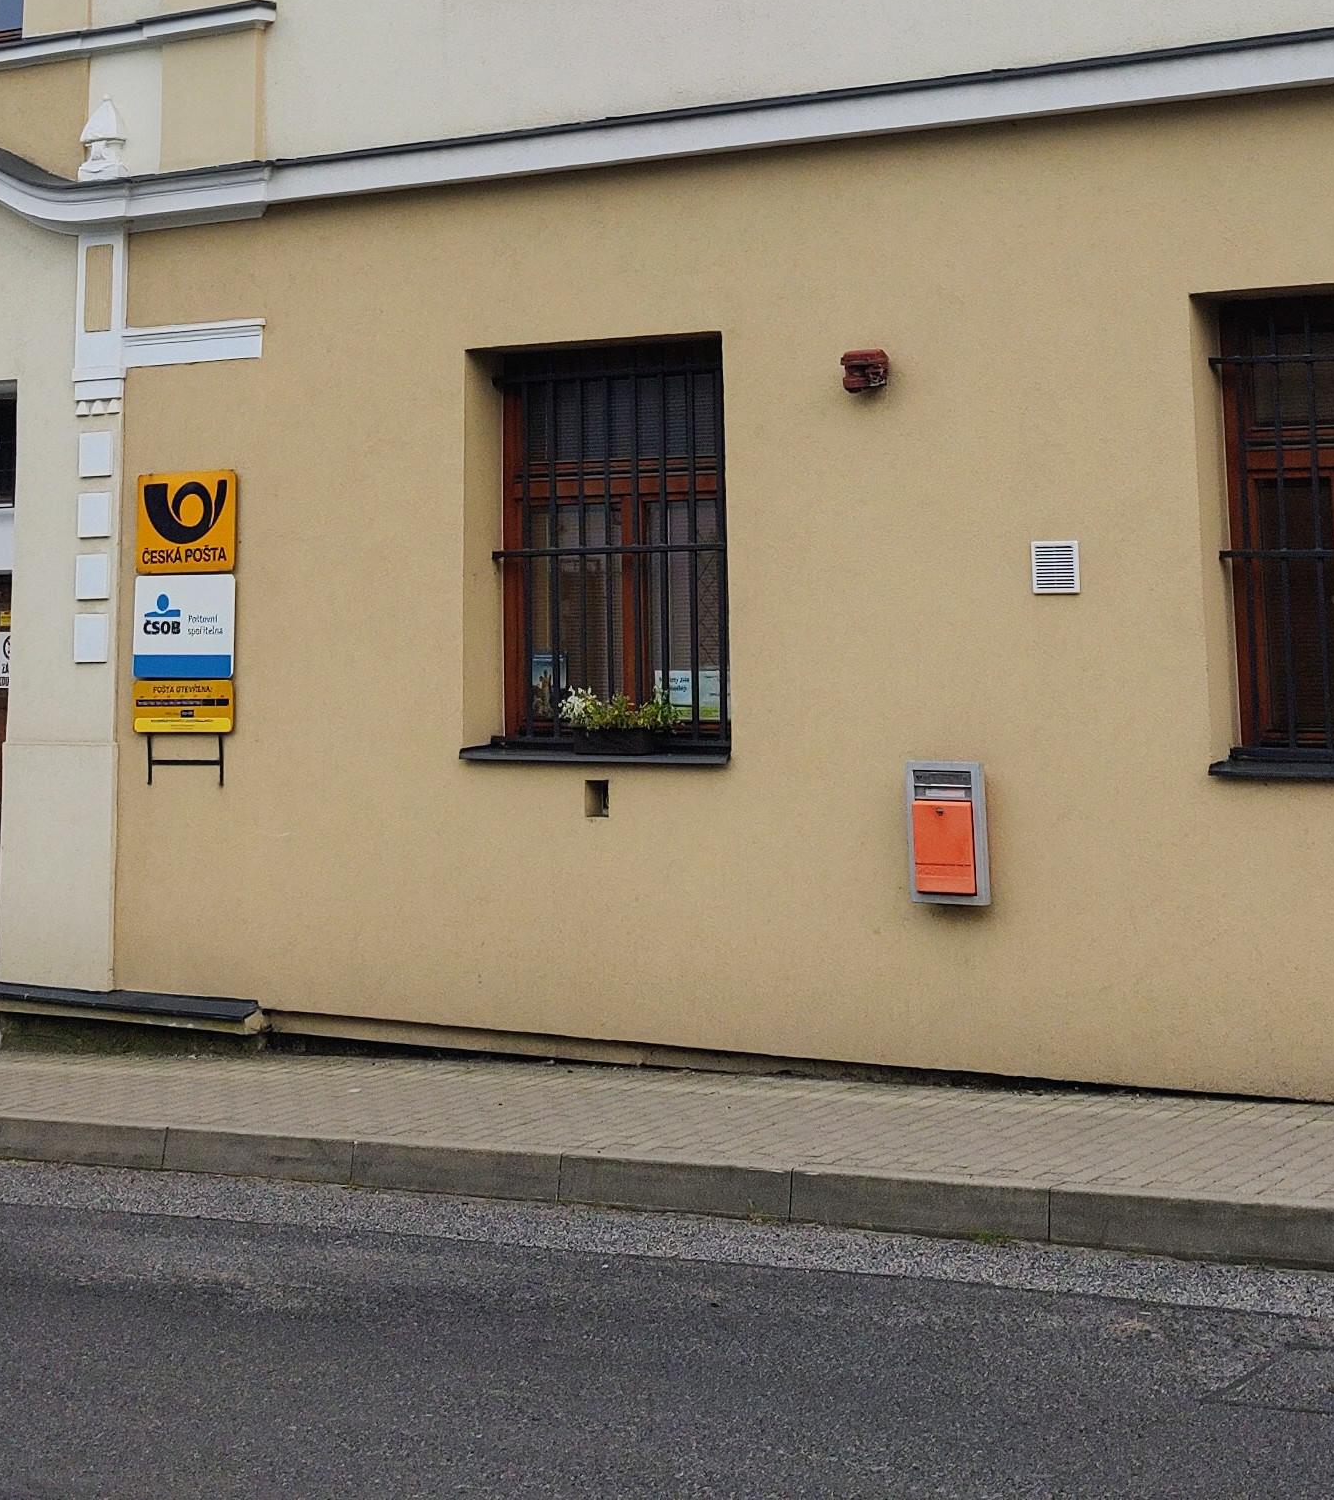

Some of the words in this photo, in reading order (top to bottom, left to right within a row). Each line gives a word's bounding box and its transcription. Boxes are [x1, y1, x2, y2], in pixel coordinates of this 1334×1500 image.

[141, 547, 182, 565] ČESKÁ
[184, 544, 227, 563] POŠTA
[143, 619, 181, 635] ČSOB
